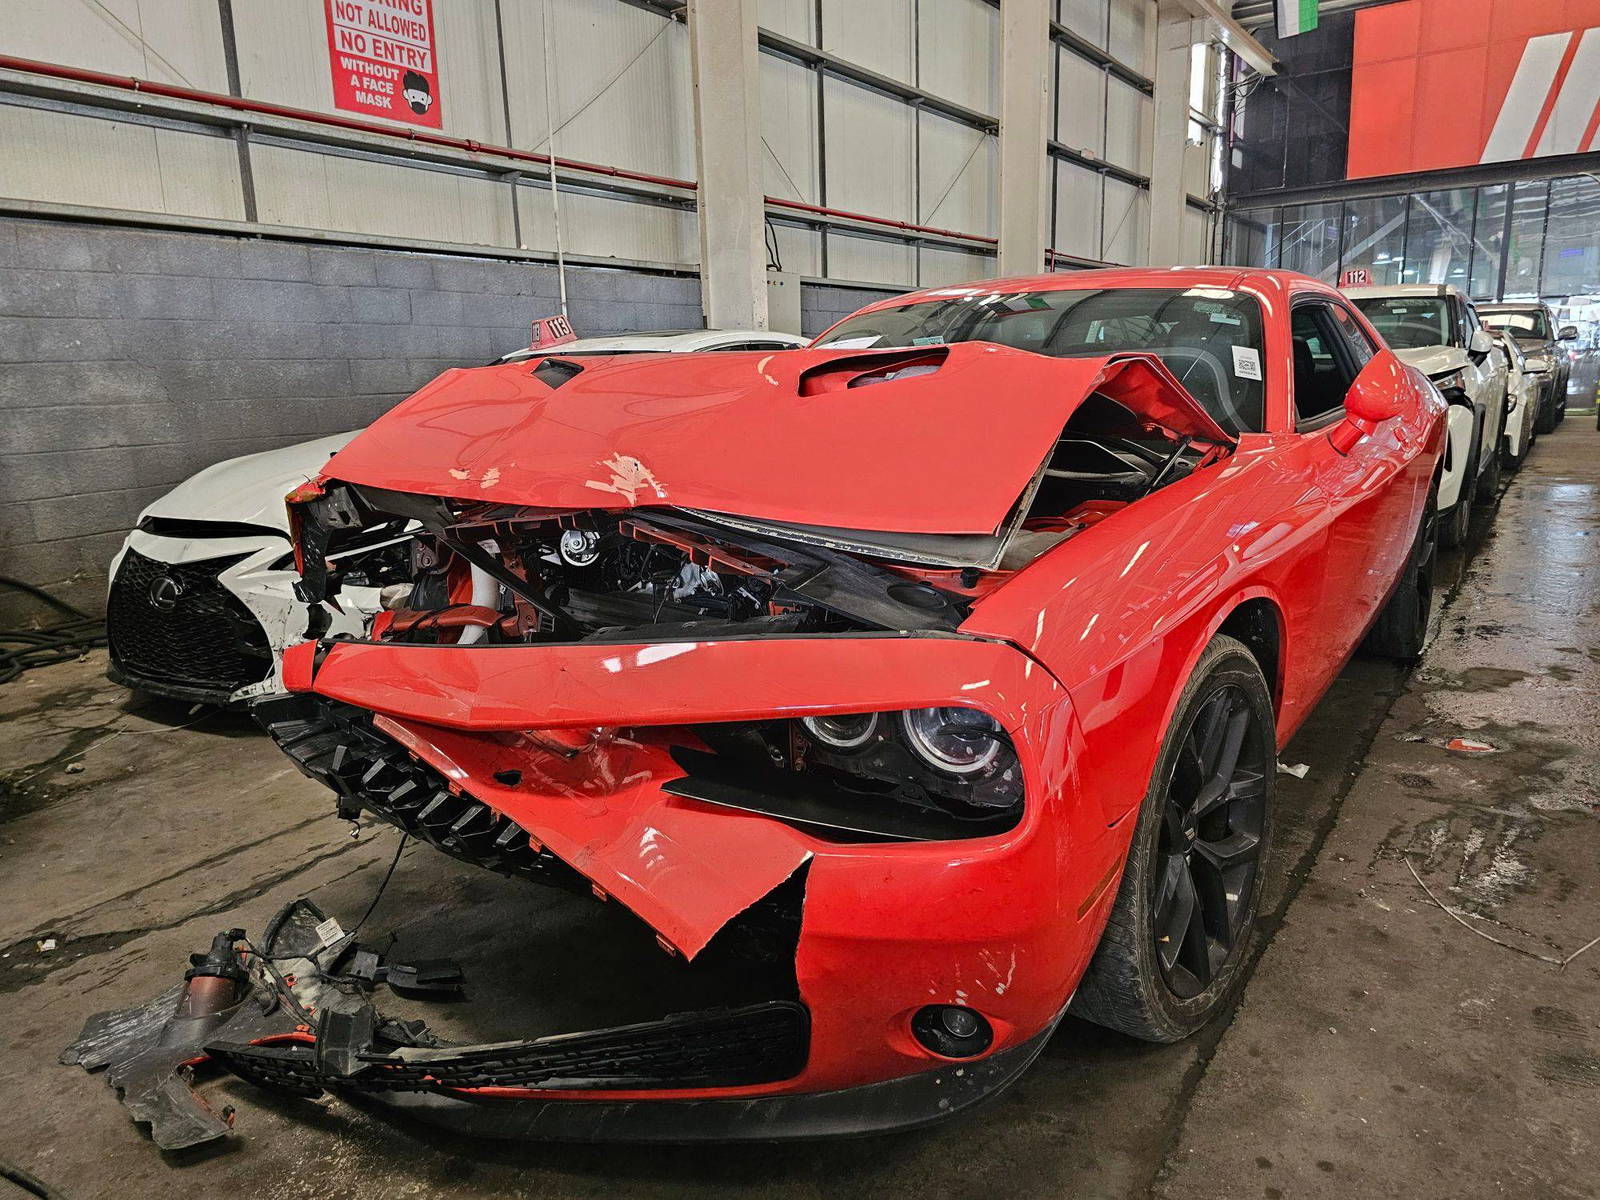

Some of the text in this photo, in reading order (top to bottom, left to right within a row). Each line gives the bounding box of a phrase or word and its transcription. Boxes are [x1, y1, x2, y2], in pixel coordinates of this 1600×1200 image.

[336, 0, 426, 42] NOT ALLOWED
[340, 30, 427, 69] NO ENTRY
[340, 56, 399, 80] WITHOUT
[350, 74, 394, 95] A FACE
[355, 90, 392, 109] MASK
[1349, 270, 1366, 283] 112
[549, 316, 570, 338] 113
